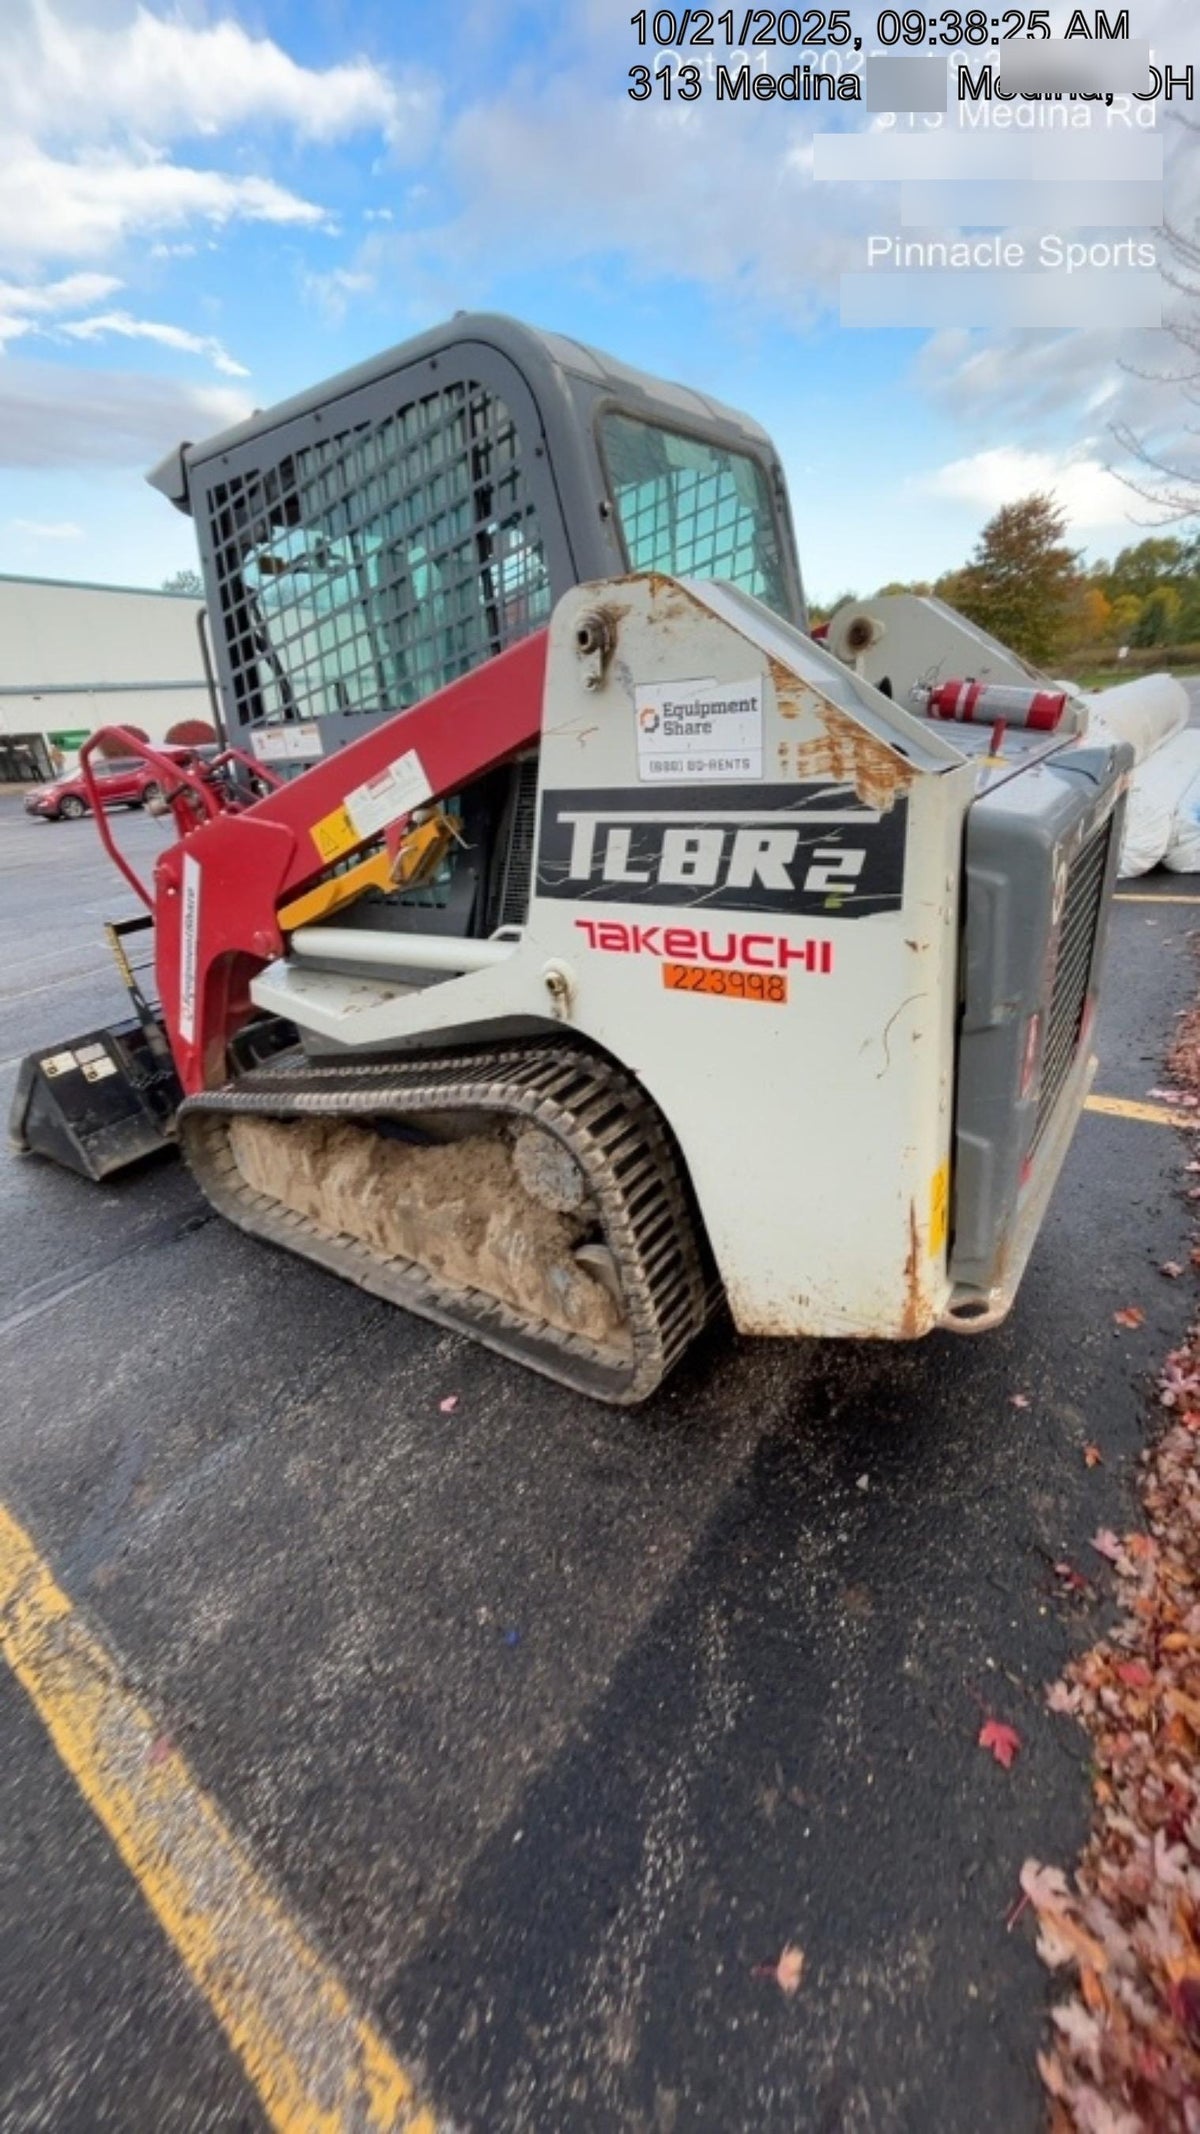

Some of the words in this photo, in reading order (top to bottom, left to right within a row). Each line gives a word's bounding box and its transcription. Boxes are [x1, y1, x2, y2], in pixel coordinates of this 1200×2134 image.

[663, 697, 758, 720] Equipment
[663, 721, 712, 735] Share
[672, 964, 787, 1002] 223998
